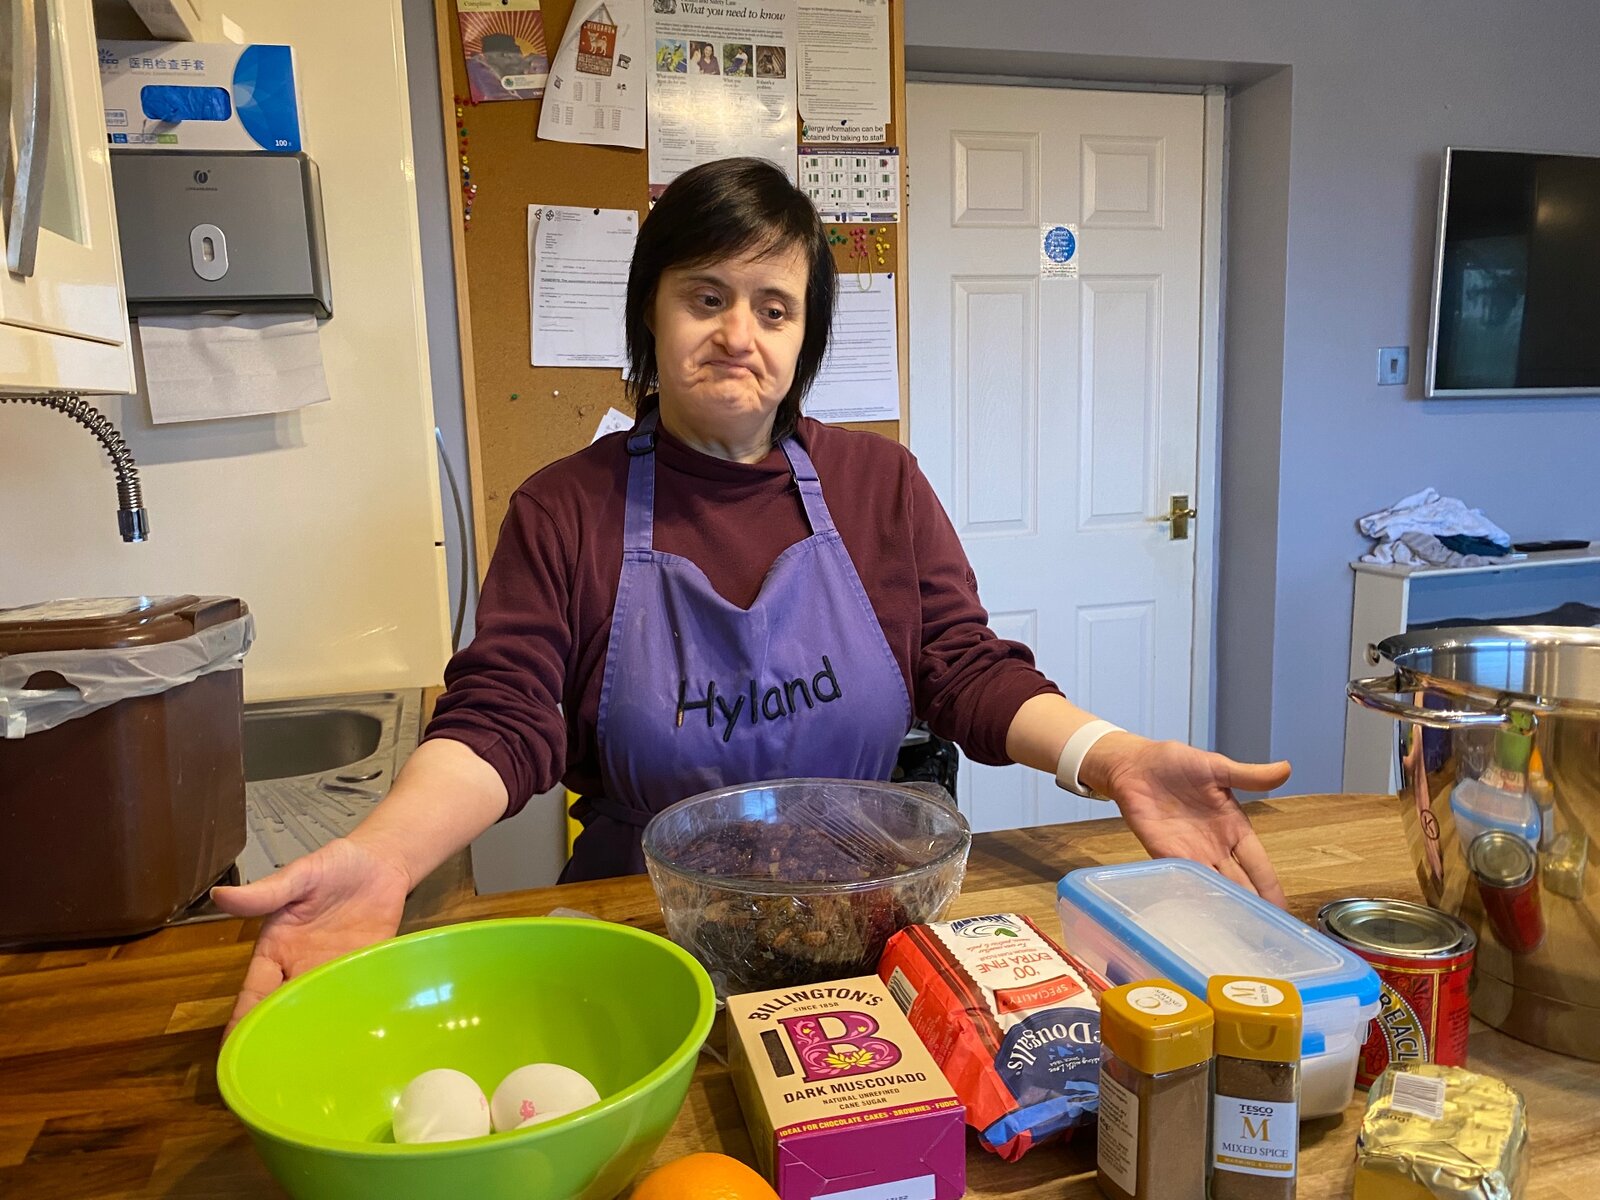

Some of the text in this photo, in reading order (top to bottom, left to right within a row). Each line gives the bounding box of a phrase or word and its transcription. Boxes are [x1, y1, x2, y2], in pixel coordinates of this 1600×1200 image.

[681, 3, 786, 20] What you need to know
[129, 57, 205, 70] 医用检查手套
[804, 125, 825, 133] Allergy
[840, 134, 860, 142] talking
[676, 655, 842, 742] Hyland
[976, 952, 1053, 973] EXTRA FINE
[1009, 983, 1069, 1005] SPECIALITY
[1230, 985, 1256, 1000] M
[748, 988, 883, 1021] BILLINGTON'S
[793, 1004, 818, 1012] SINCE
[1379, 993, 1419, 1061] REACL
[1007, 1022, 1101, 1072] cDougalls
[784, 1072, 927, 1104] DARK MUSCOVADO
[822, 1088, 900, 1105] NATURAL UNREFINED
[839, 1097, 887, 1110] CANE SUGAR
[1239, 1104, 1273, 1114] TESCO
[779, 1100, 959, 1137] IDEAL FOR CHOCOLATE CAKES BROWNIES FUDGE
[1240, 1116, 1271, 1142] M
[1222, 1142, 1289, 1158] MIXED SPICE
